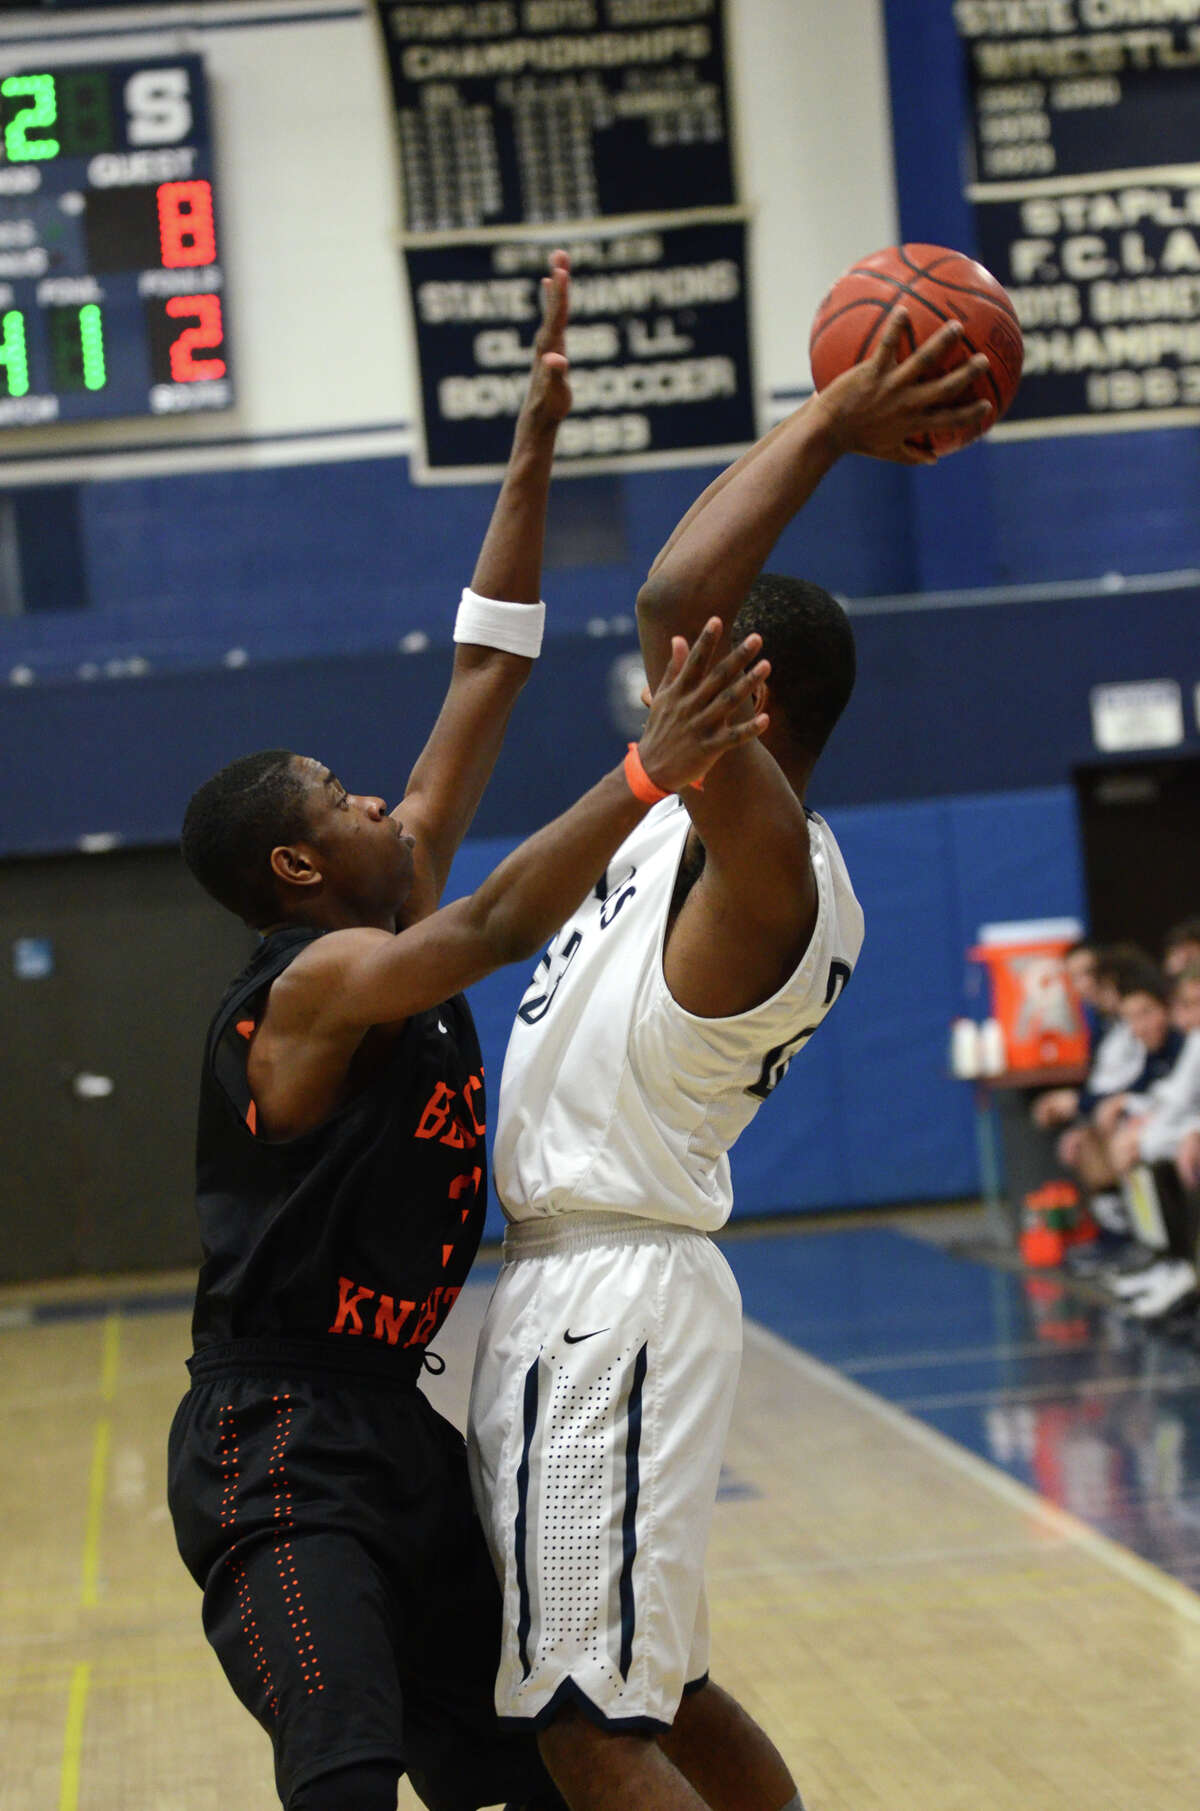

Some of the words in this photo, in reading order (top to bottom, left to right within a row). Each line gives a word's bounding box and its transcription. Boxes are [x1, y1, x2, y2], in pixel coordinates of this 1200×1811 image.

[1, 74, 60, 162] 2
[124, 68, 194, 146] S
[88, 147, 196, 188] GUEST
[157, 180, 217, 268] 8
[418, 277, 537, 324] STATE
[540, 259, 740, 317] HAMPIONS
[79, 304, 107, 391] 1
[166, 294, 227, 383] 2
